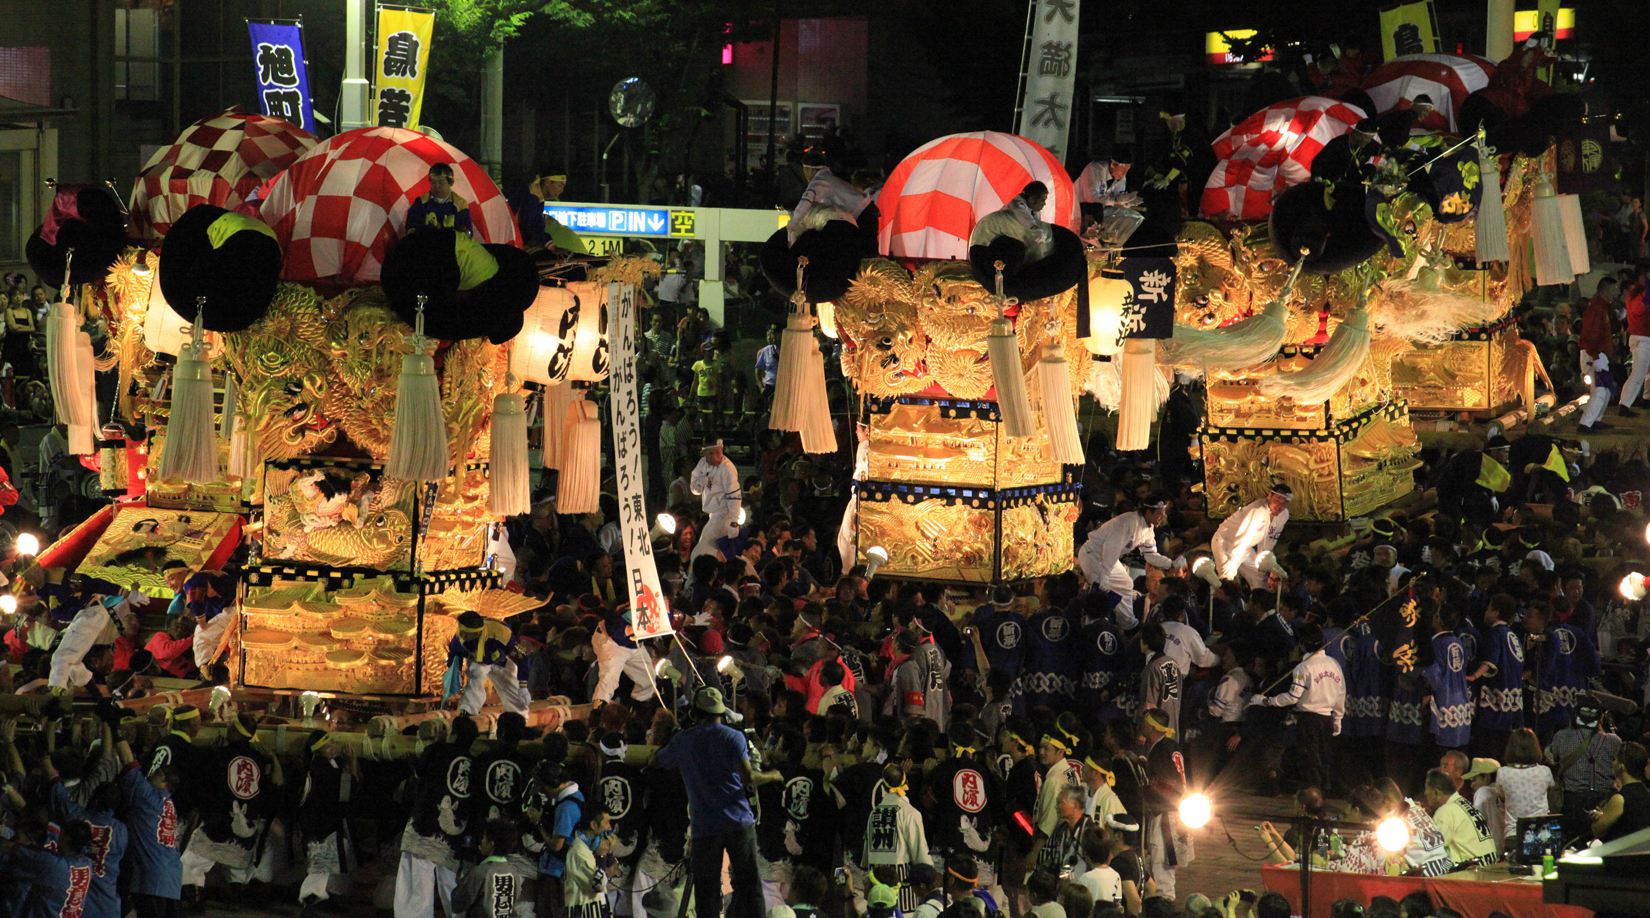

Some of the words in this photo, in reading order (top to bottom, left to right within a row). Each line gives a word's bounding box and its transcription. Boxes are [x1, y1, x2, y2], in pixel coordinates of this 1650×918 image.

[257, 43, 304, 129] 旭町
[628, 211, 646, 232] IN
[671, 210, 695, 236] 空
